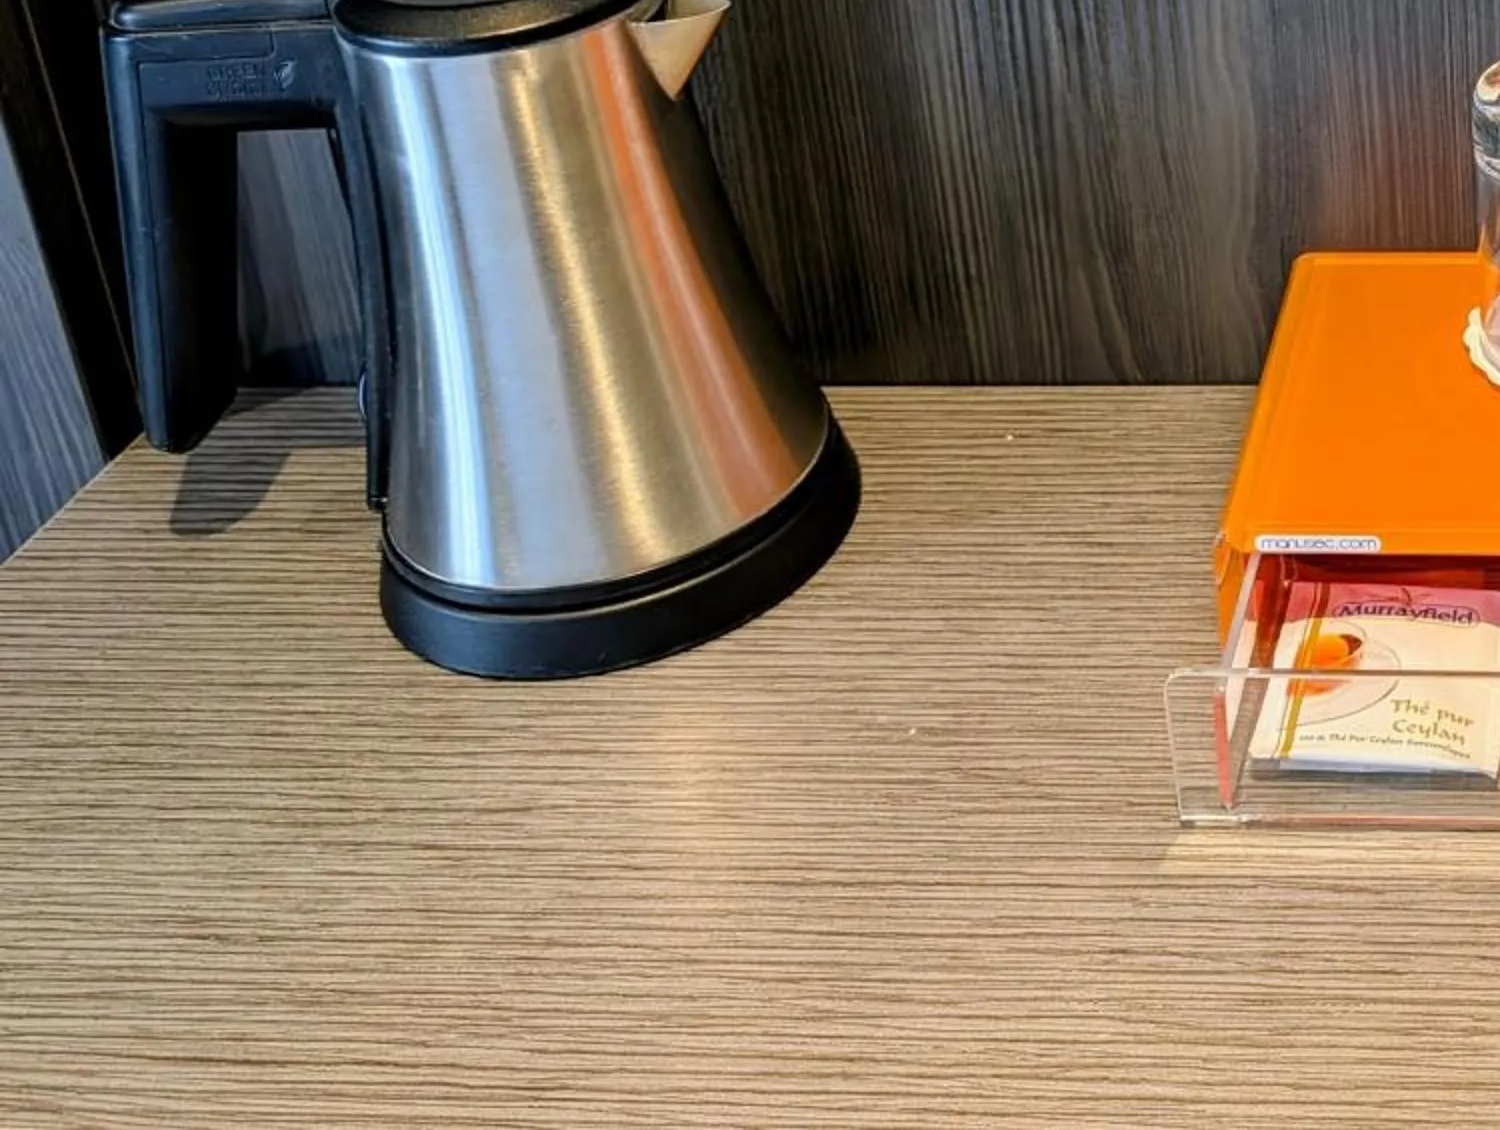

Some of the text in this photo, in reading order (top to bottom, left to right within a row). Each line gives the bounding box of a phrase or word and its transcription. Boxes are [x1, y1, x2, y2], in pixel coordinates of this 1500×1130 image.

[1338, 603, 1473, 625] Murrayfield
[1391, 698, 1475, 726] Thé pur
[1392, 718, 1466, 747] Ceylan
